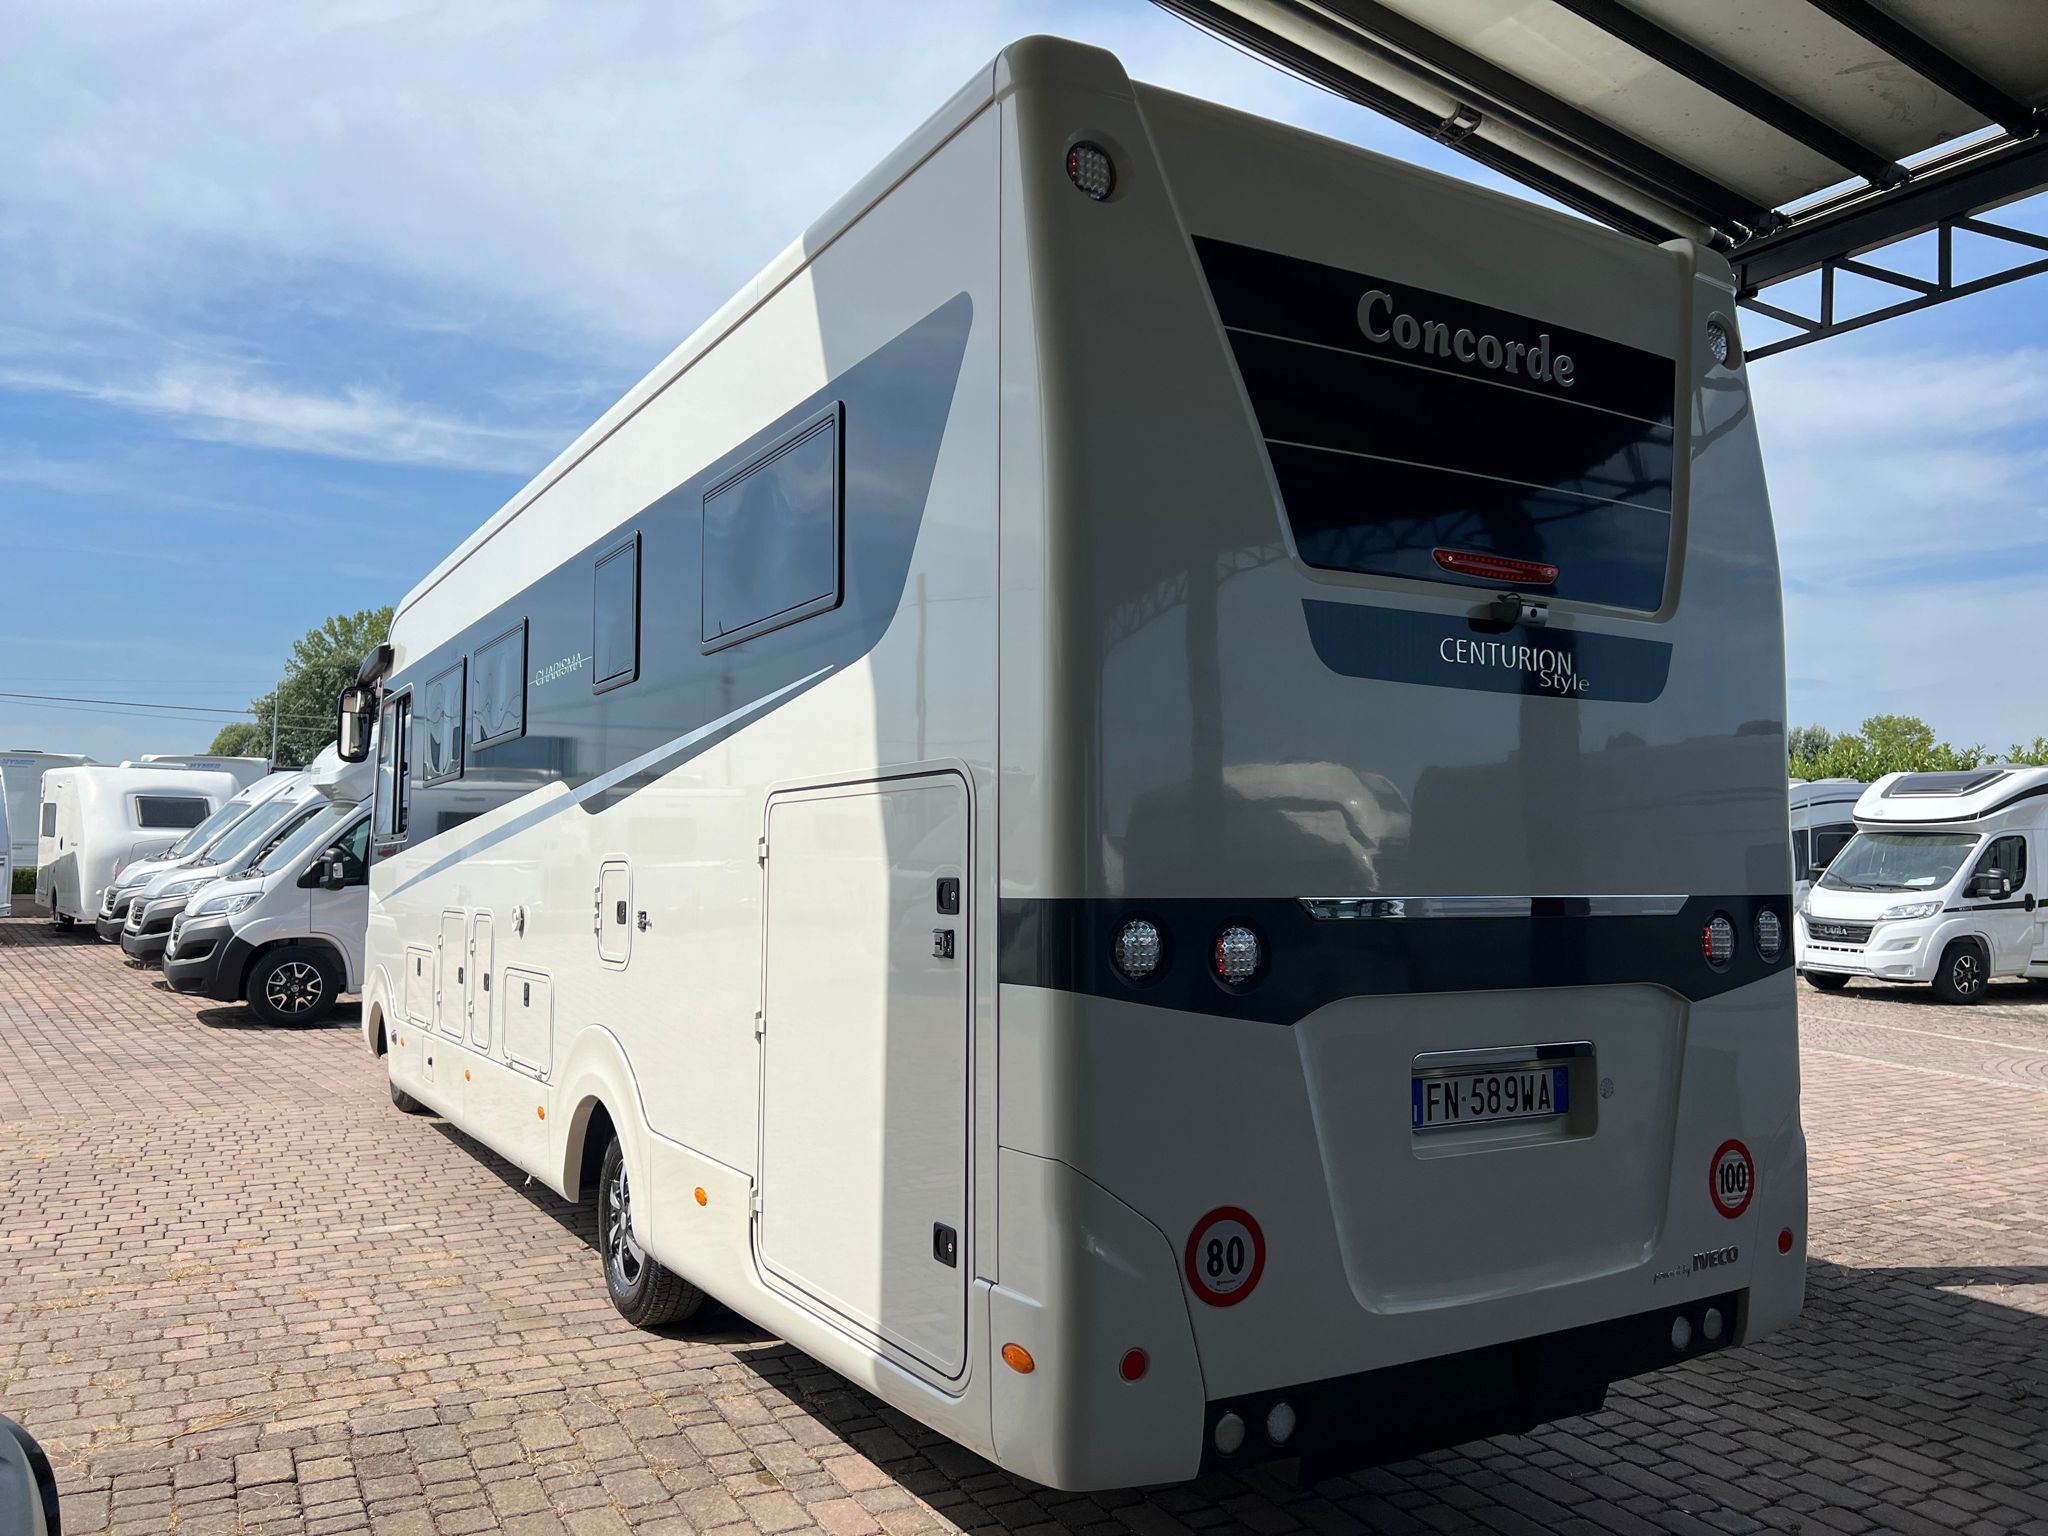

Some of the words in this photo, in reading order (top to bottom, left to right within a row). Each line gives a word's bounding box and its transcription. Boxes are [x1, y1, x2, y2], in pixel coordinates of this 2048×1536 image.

[1356, 289, 1576, 388] Concorde
[535, 652, 583, 687] CHARISMA
[1439, 637, 1573, 676] CENTURION
[1539, 669, 1591, 695] Style
[1426, 1081, 1460, 1122] FN
[1470, 1073, 1551, 1116] 589WA
[1719, 1161, 1746, 1195] 100
[1206, 1235, 1245, 1278] 80
[1692, 1245, 1739, 1272] IVECO
